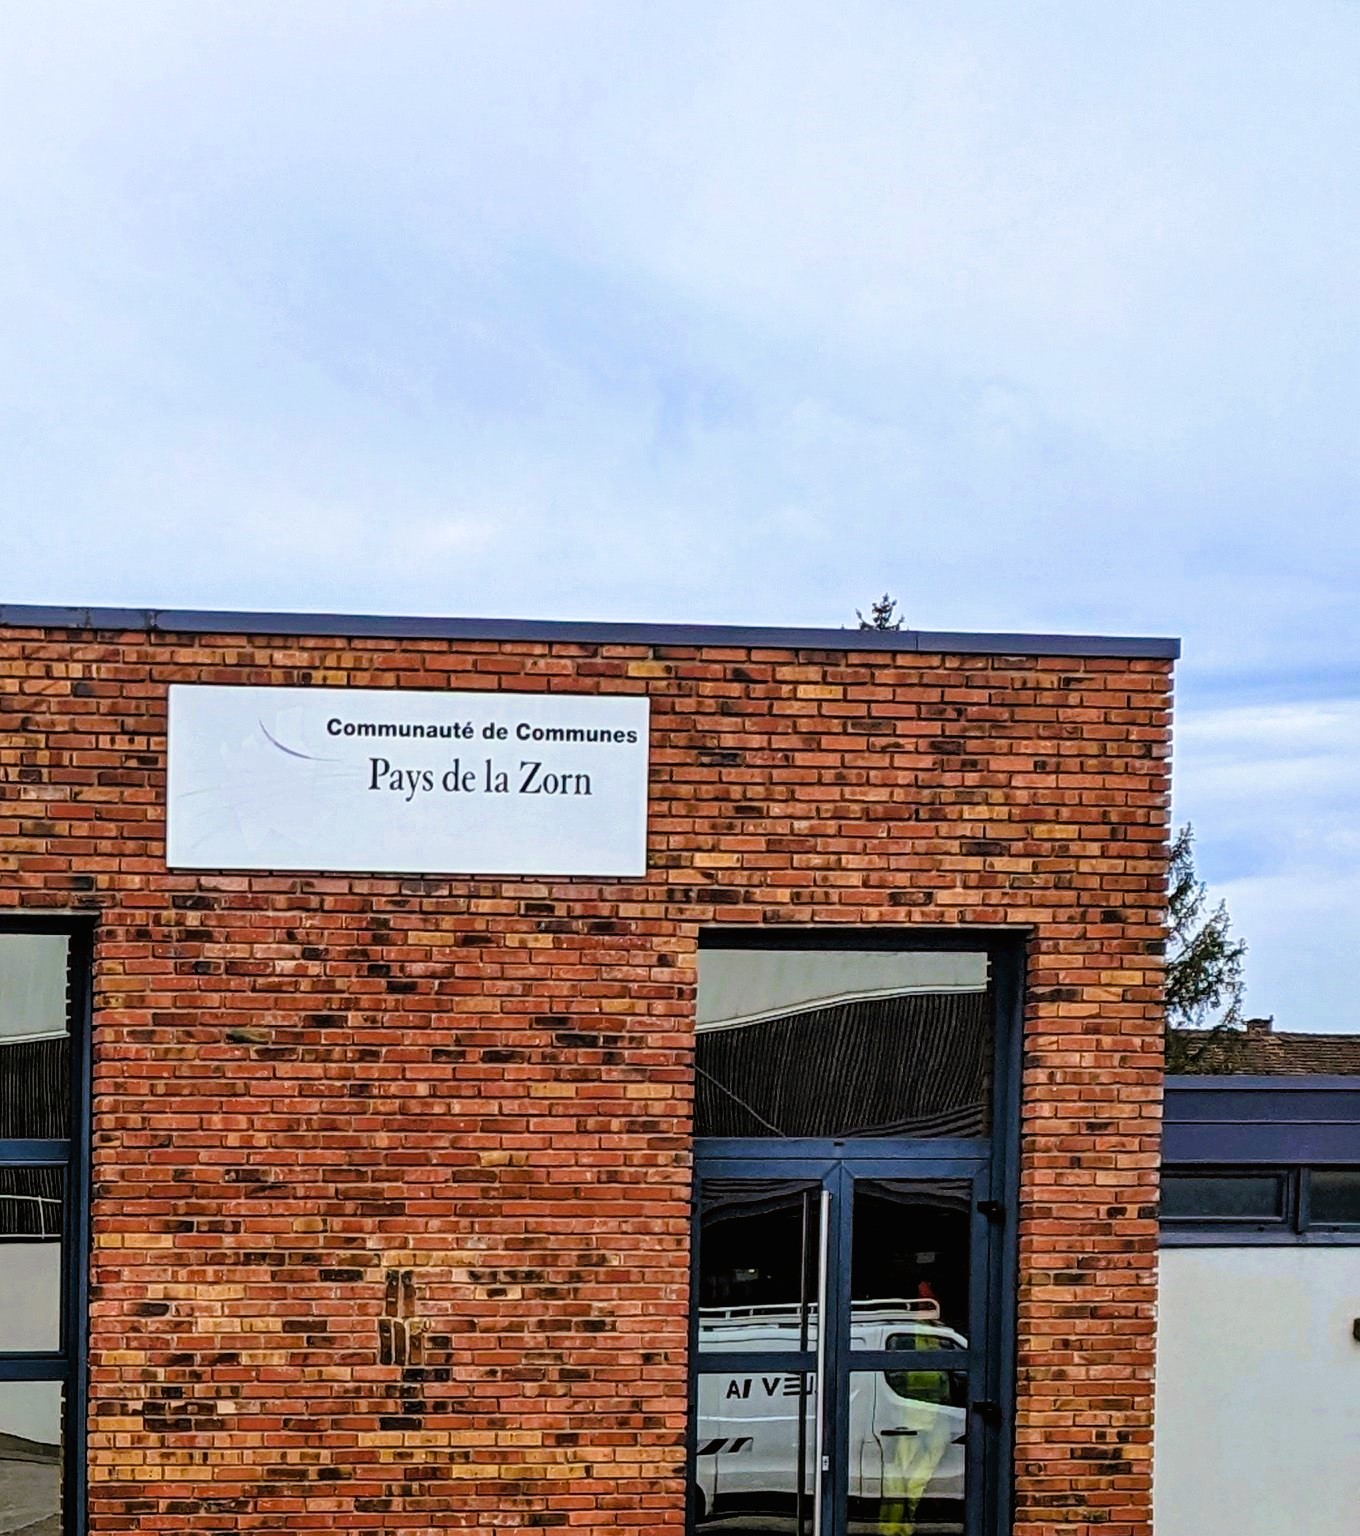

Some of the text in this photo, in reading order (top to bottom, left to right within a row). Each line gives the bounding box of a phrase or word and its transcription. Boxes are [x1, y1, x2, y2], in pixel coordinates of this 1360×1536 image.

[327, 718, 638, 743] Communauté de Communes
[368, 757, 592, 802] Pays de la Zorn
